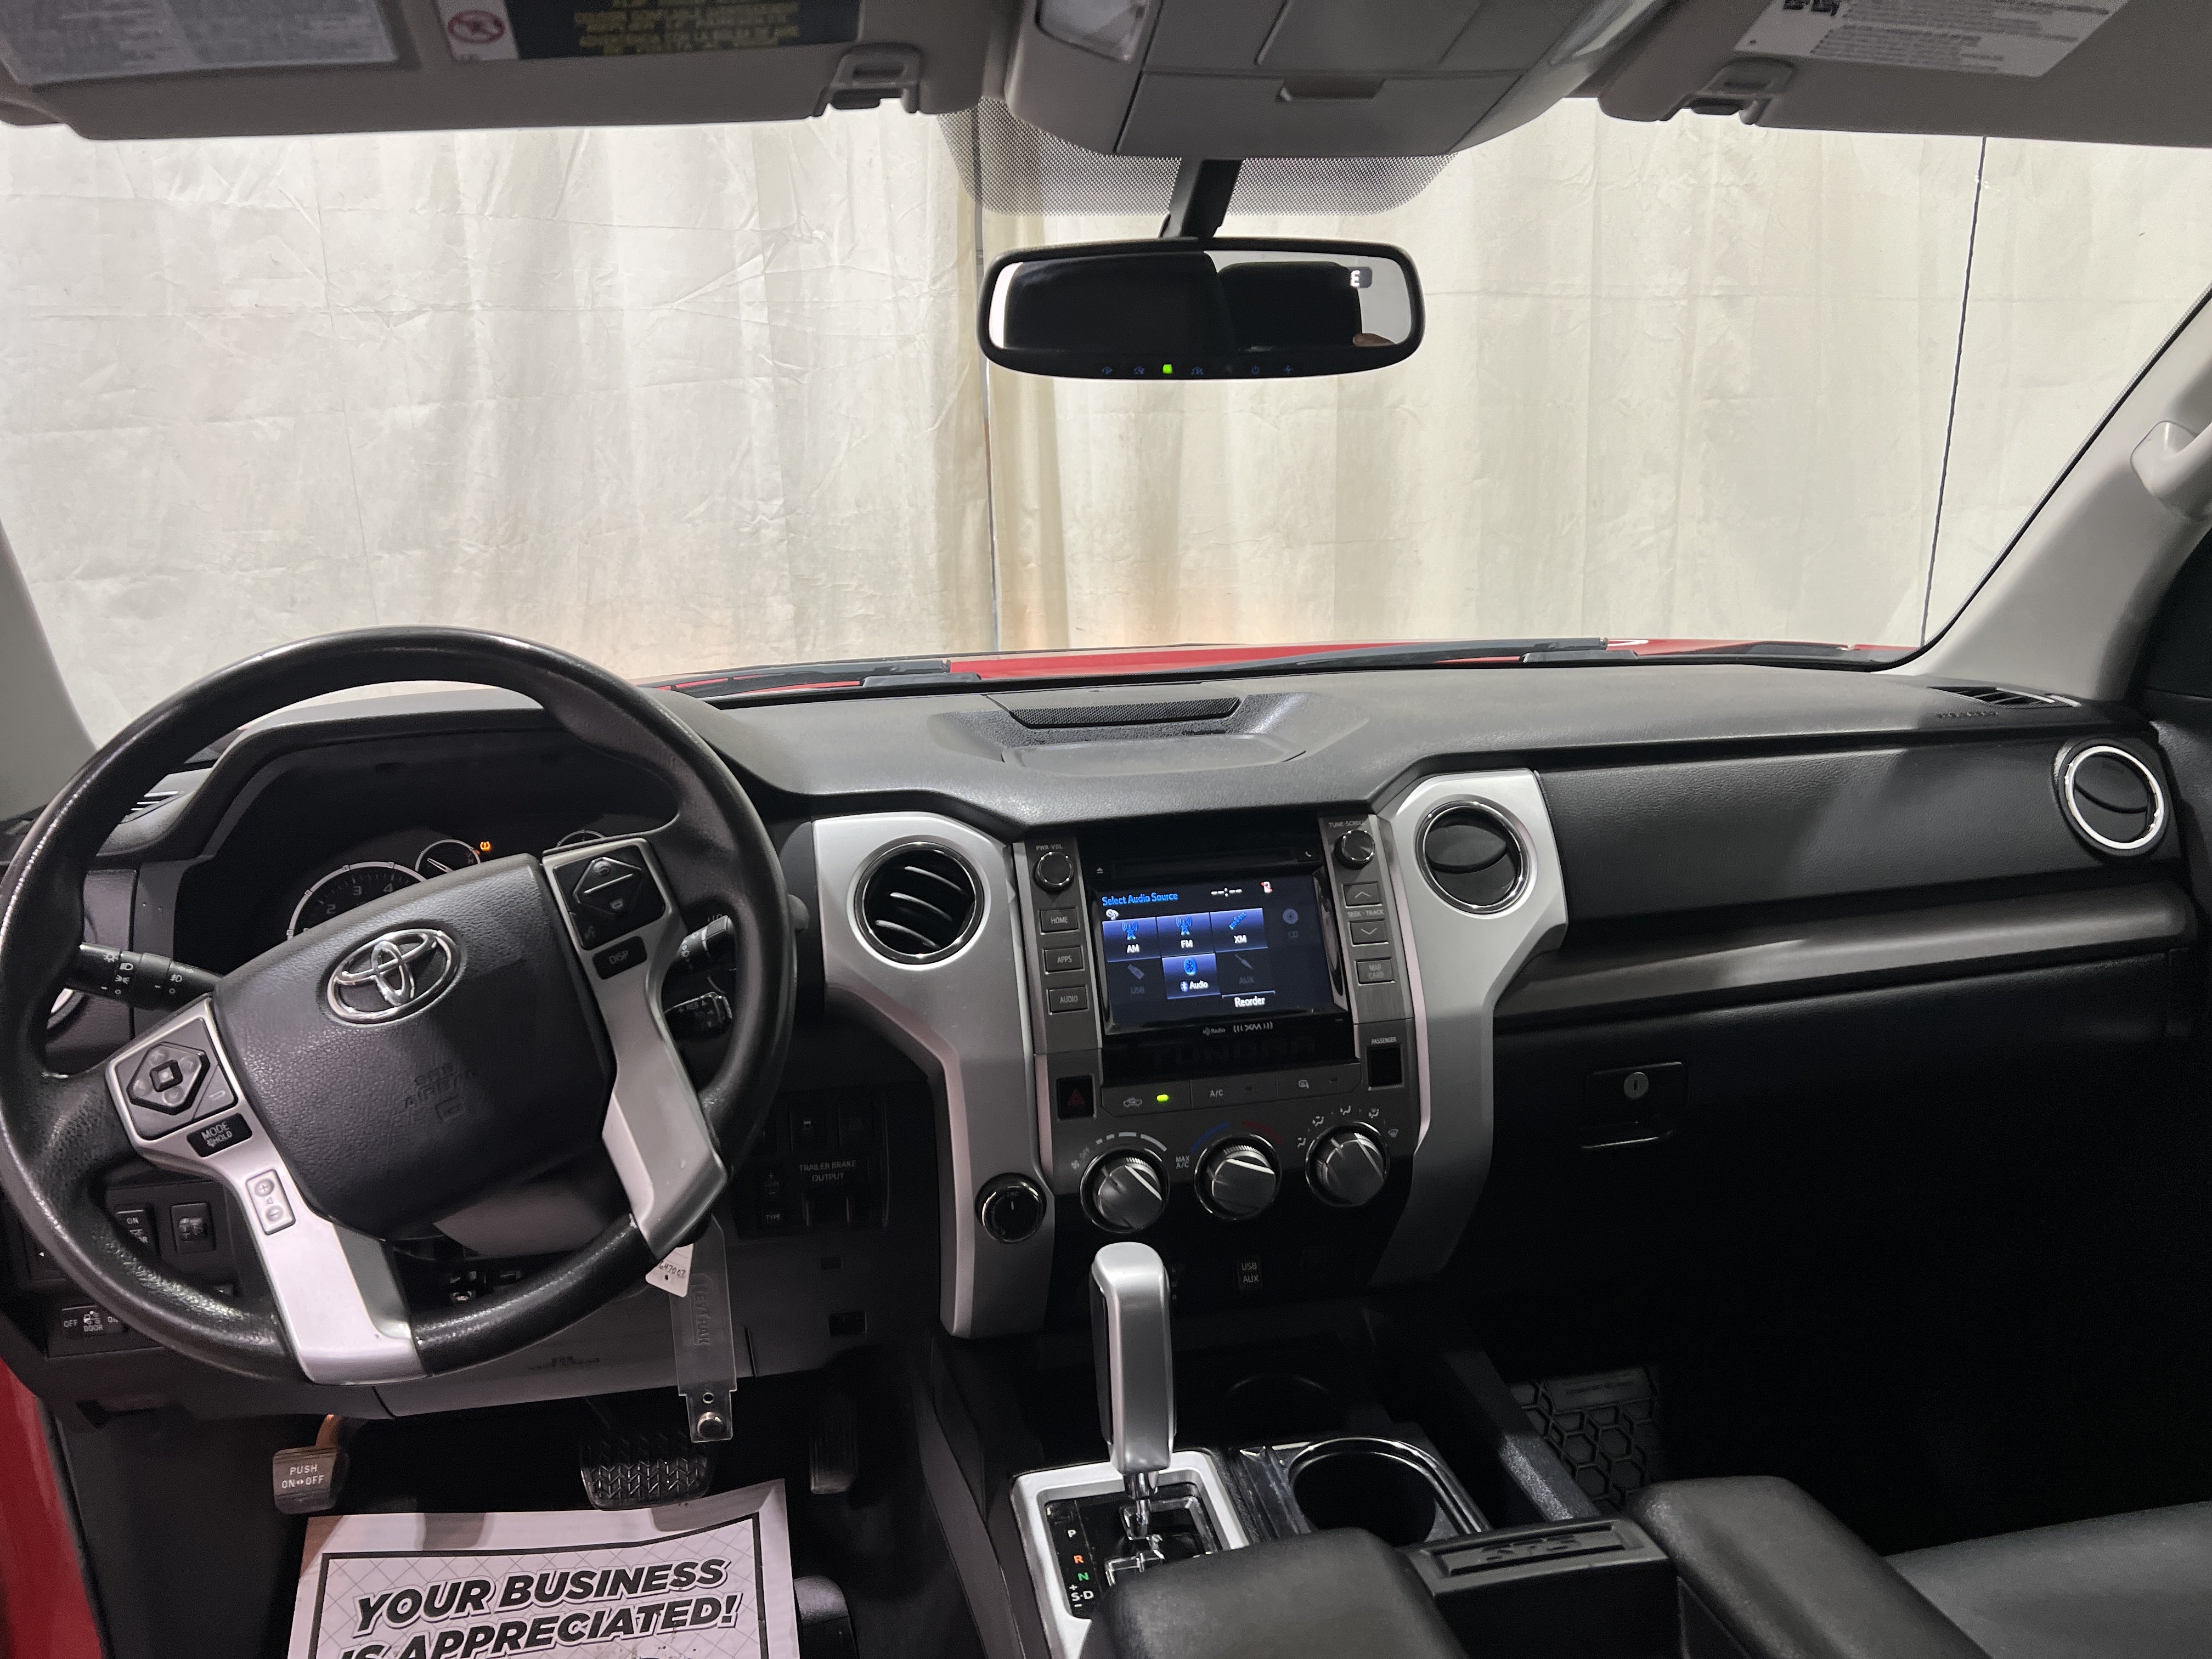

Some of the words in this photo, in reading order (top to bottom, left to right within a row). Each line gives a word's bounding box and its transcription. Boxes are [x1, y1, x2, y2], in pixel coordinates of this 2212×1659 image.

[353, 885, 362, 896] 3
[383, 883, 393, 893] 4
[1102, 894, 1126, 906] Select
[1128, 893, 1150, 904] Audio
[1152, 892, 1178, 902] Source
[1051, 916, 1069, 924] HOME
[1181, 939, 1194, 949] FM
[1234, 934, 1248, 944] XM
[1126, 944, 1140, 953] AM
[1057, 956, 1073, 964] APPS
[1189, 980, 1209, 990] Audio
[1059, 995, 1078, 1004] AUDIO
[1234, 996, 1266, 1008] Reorder
[1209, 1089, 1224, 1097] A/C
[201, 1120, 229, 1141] MODE
[1175, 1154, 1190, 1163] MAX
[799, 1162, 830, 1172] TRAILER
[832, 1160, 856, 1170] BRAKE
[1176, 1161, 1189, 1169] A/C
[812, 1172, 845, 1182] OUTPUT
[1241, 1262, 1257, 1271] USB
[1243, 1274, 1259, 1283] AUX
[64, 1319, 78, 1328] OFF
[290, 1464, 318, 1476] PUSH
[281, 1480, 295, 1489] ON
[306, 1475, 325, 1485] OFF
[1067, 1529, 1076, 1538] P
[1073, 1555, 1085, 1564] R
[1077, 1572, 1090, 1582] N
[355, 1578, 493, 1634] YOUR
[498, 1558, 729, 1608] BUSINESS
[395, 1594, 739, 1659] APPRECIATED!
